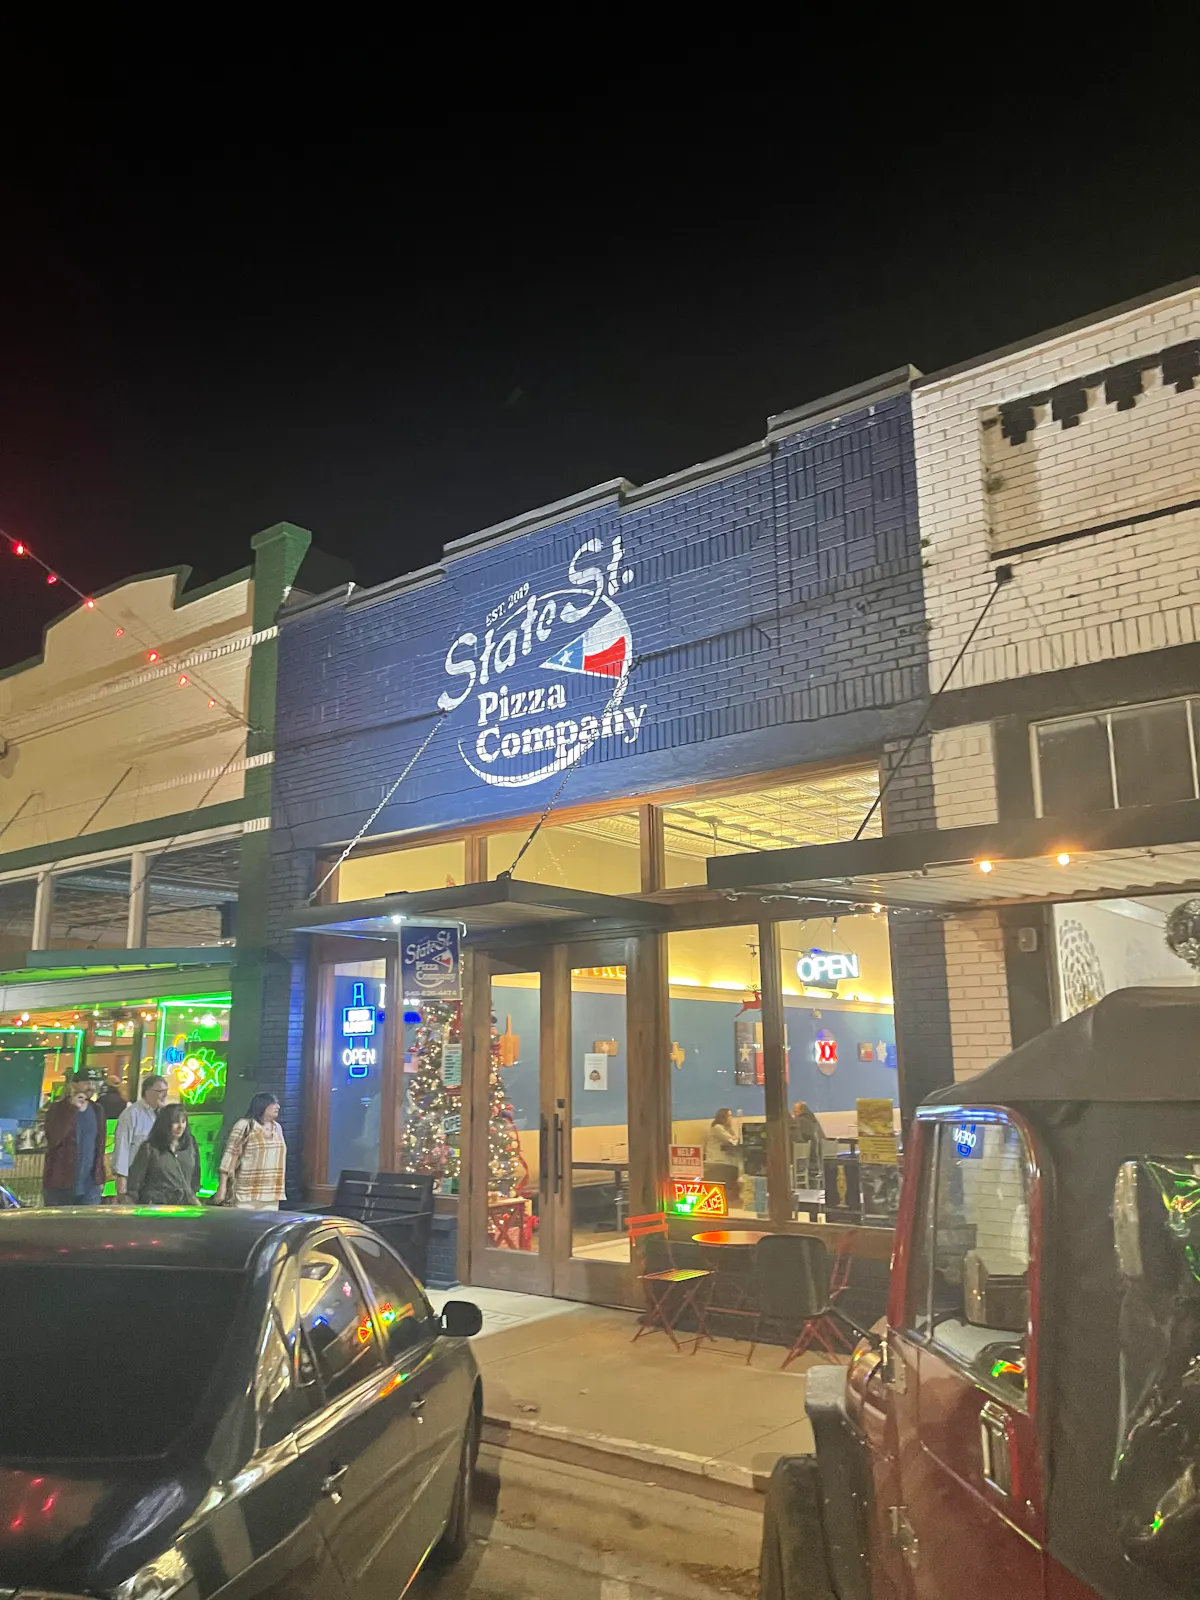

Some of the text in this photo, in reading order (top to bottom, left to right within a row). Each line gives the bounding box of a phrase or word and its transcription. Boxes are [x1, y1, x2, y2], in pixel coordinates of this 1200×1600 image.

[485, 582, 530, 627] EST. 2019
[437, 536, 634, 711] State St.
[476, 684, 566, 726] Pizza
[475, 703, 648, 763] Company
[796, 953, 859, 982] OPEN
[342, 1048, 376, 1066] OPEN
[443, 1116, 461, 1131] OPE
[676, 1147, 696, 1157] HELP
[674, 1183, 708, 1202] PIZZA
[675, 1203, 692, 1213] THE
